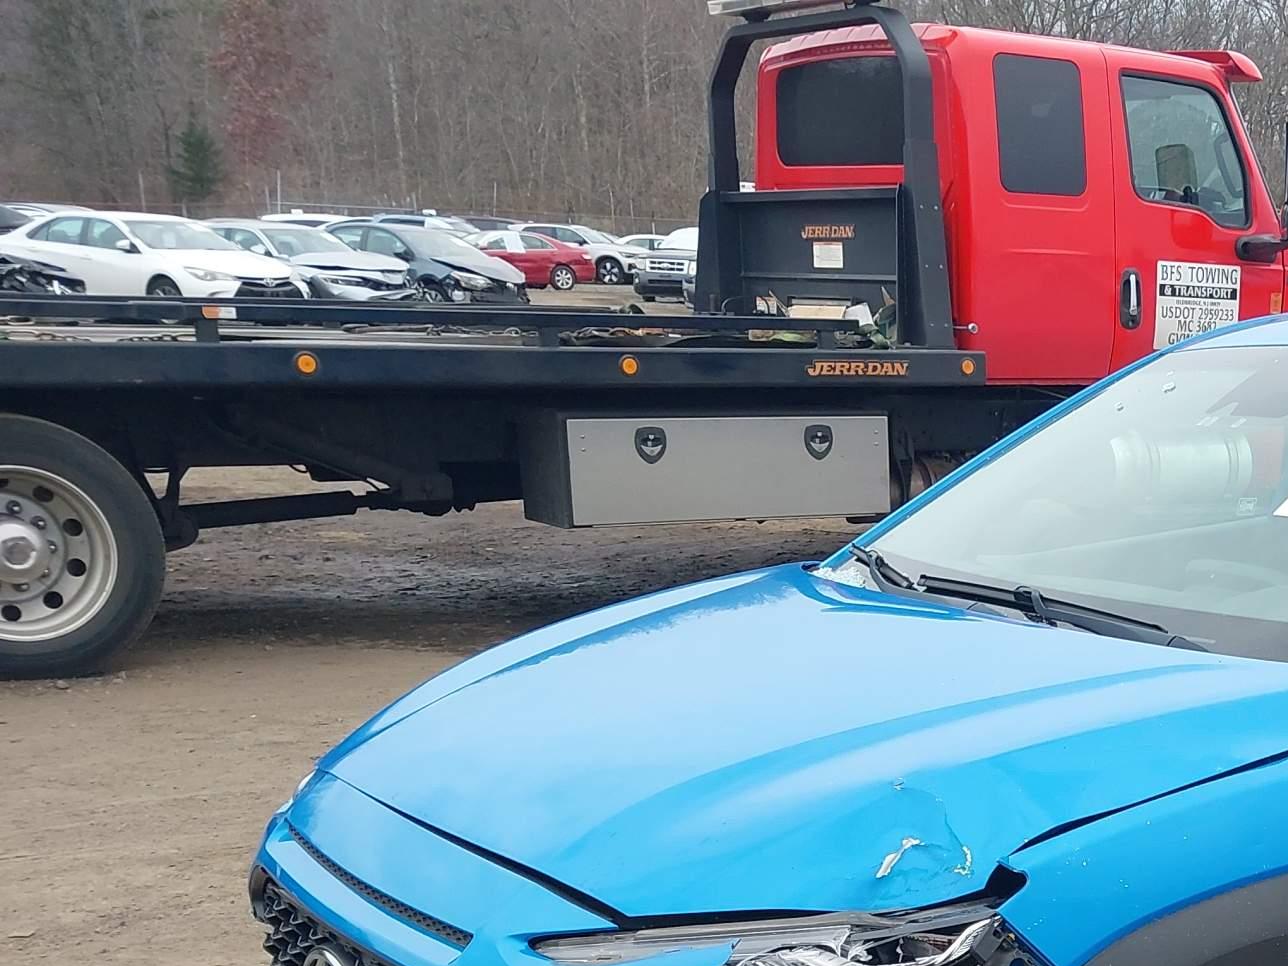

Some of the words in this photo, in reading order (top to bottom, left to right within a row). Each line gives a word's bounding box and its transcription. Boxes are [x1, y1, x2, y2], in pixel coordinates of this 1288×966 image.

[1161, 265, 1182, 282] BFS
[1189, 266, 1238, 285] TOWING
[1164, 285, 1172, 296] &
[1174, 285, 1233, 299] TRANSPORT
[1161, 306, 1197, 320] USDOT
[1198, 307, 1234, 322] 2959233
[1177, 320, 1193, 333] MC
